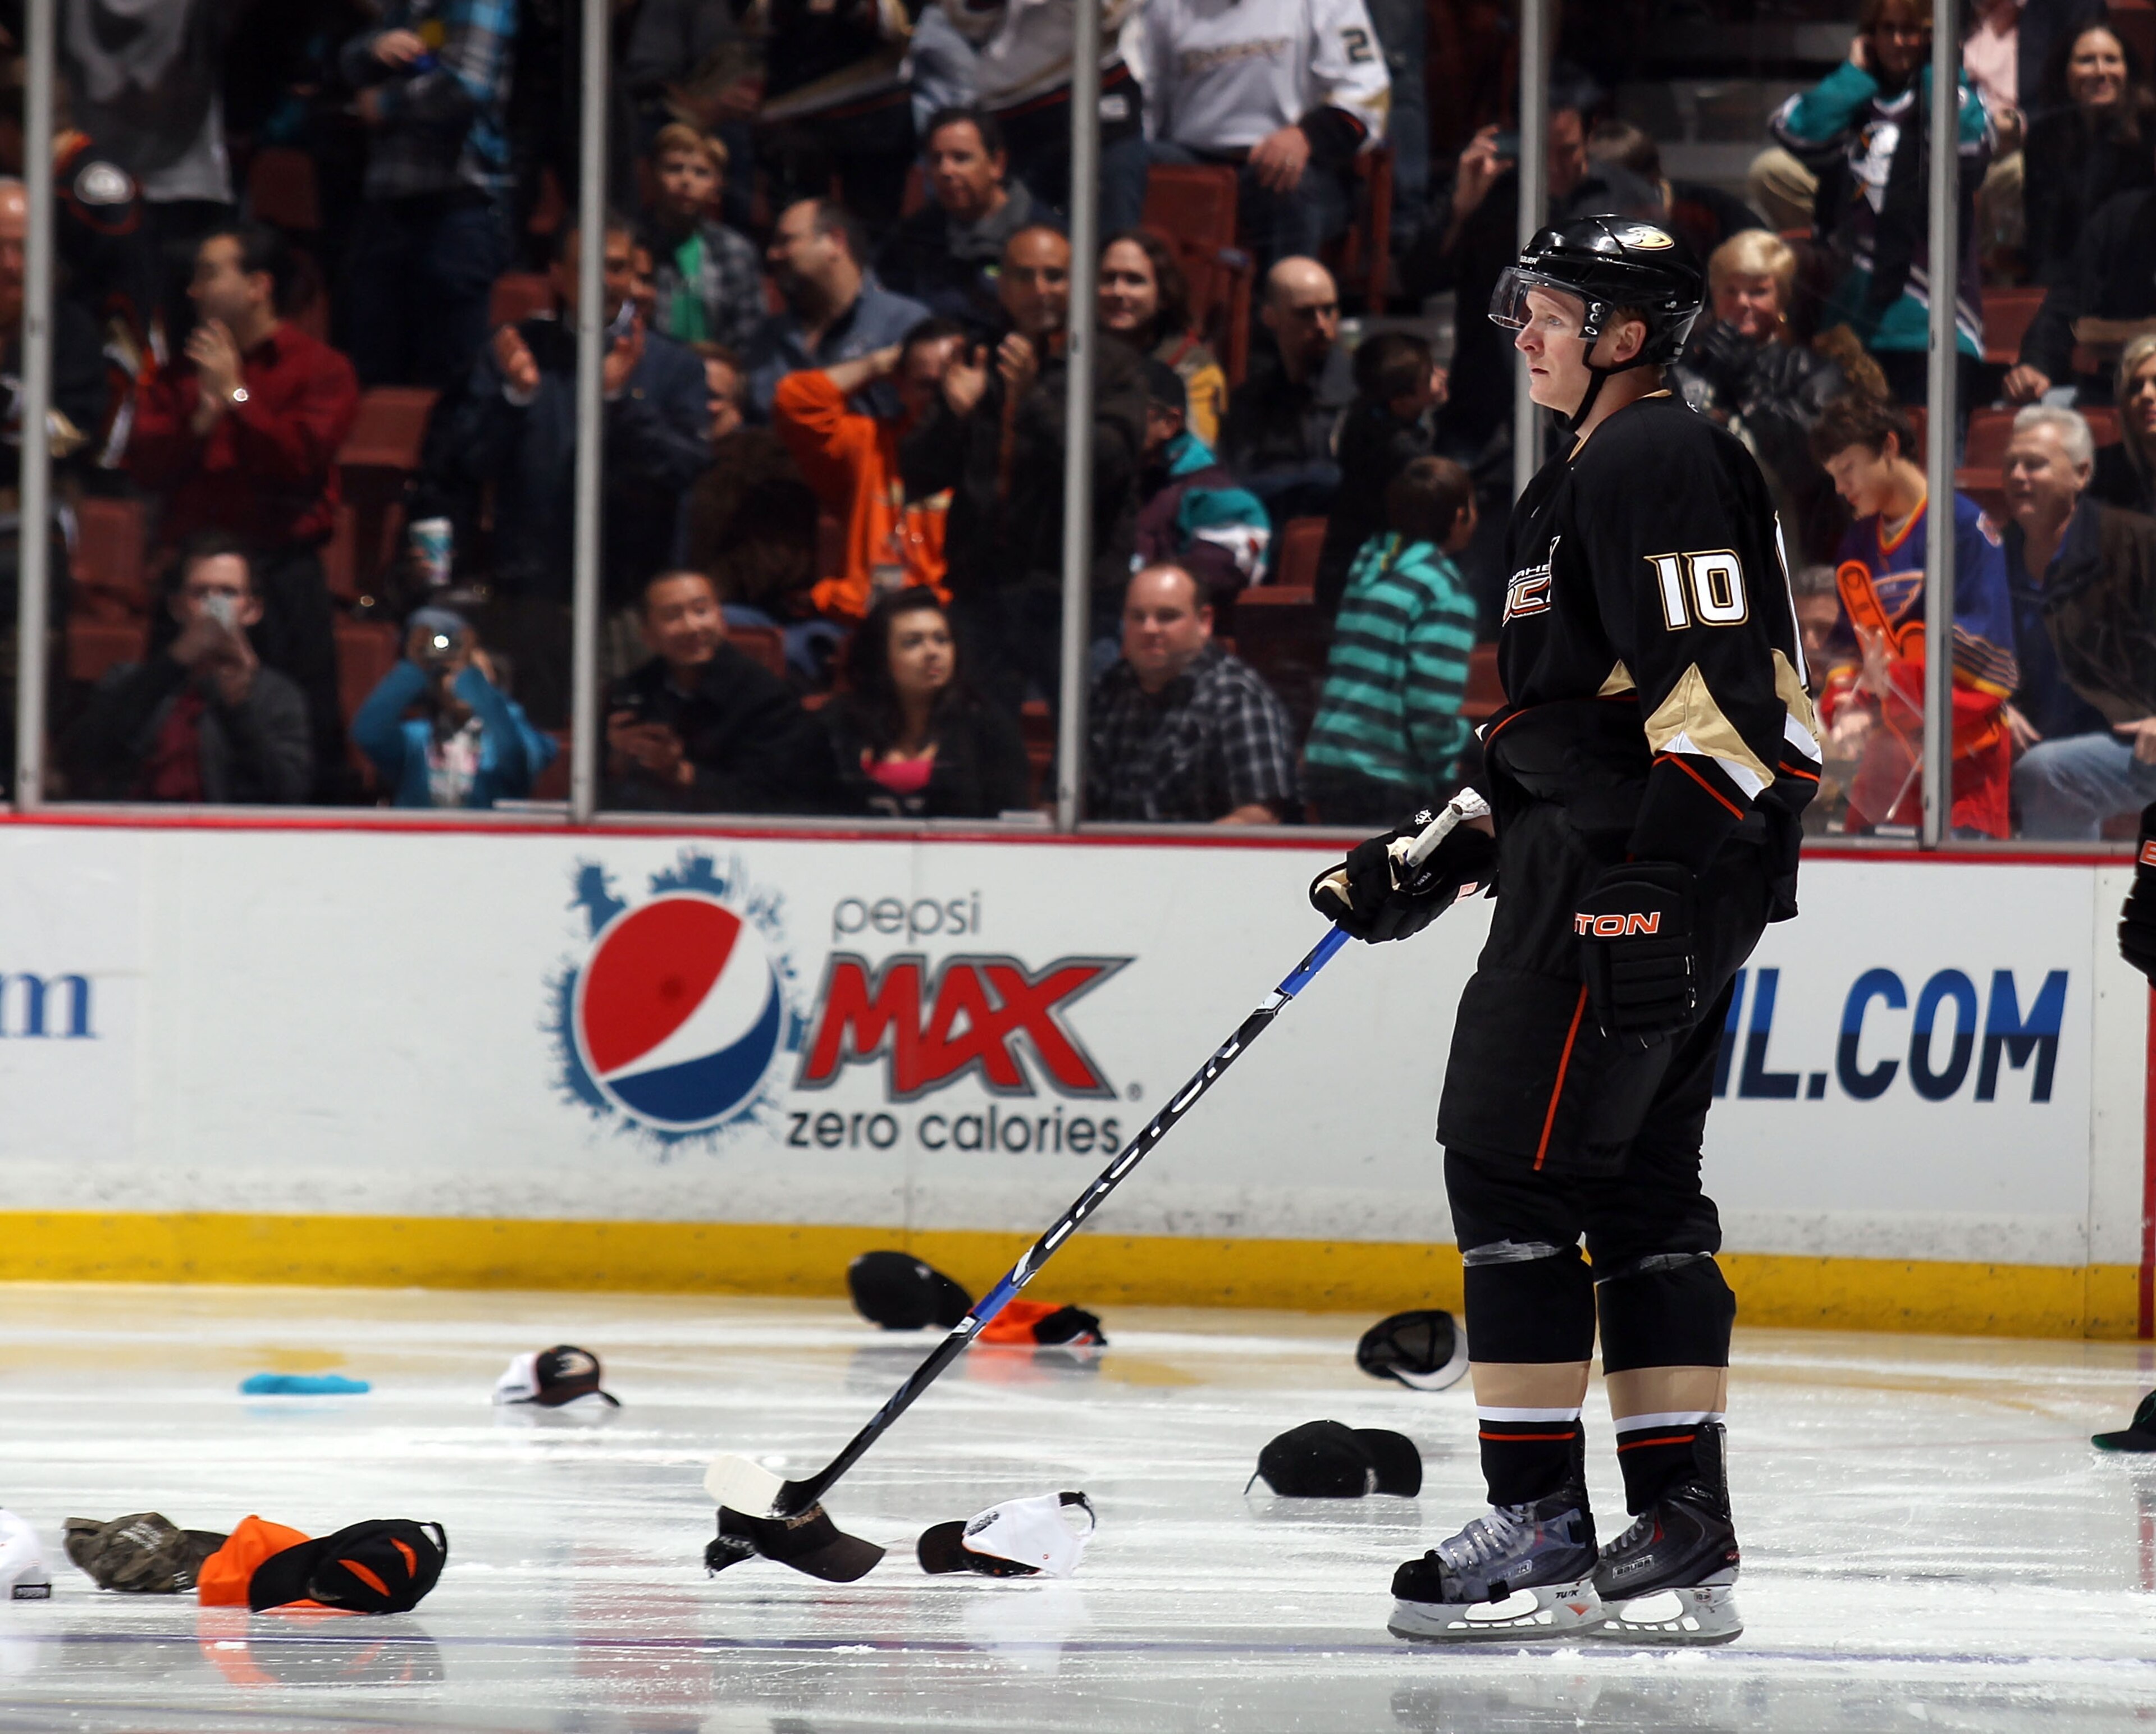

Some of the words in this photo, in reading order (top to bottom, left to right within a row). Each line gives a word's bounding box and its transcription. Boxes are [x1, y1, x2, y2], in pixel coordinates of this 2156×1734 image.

[1643, 548, 1748, 632] 10
[833, 891, 980, 943] pepsi
[1574, 912, 1661, 937] TON
[792, 953, 1137, 1104] MAX
[787, 1111, 901, 1149] zero
[918, 1105, 1121, 1154] calories
